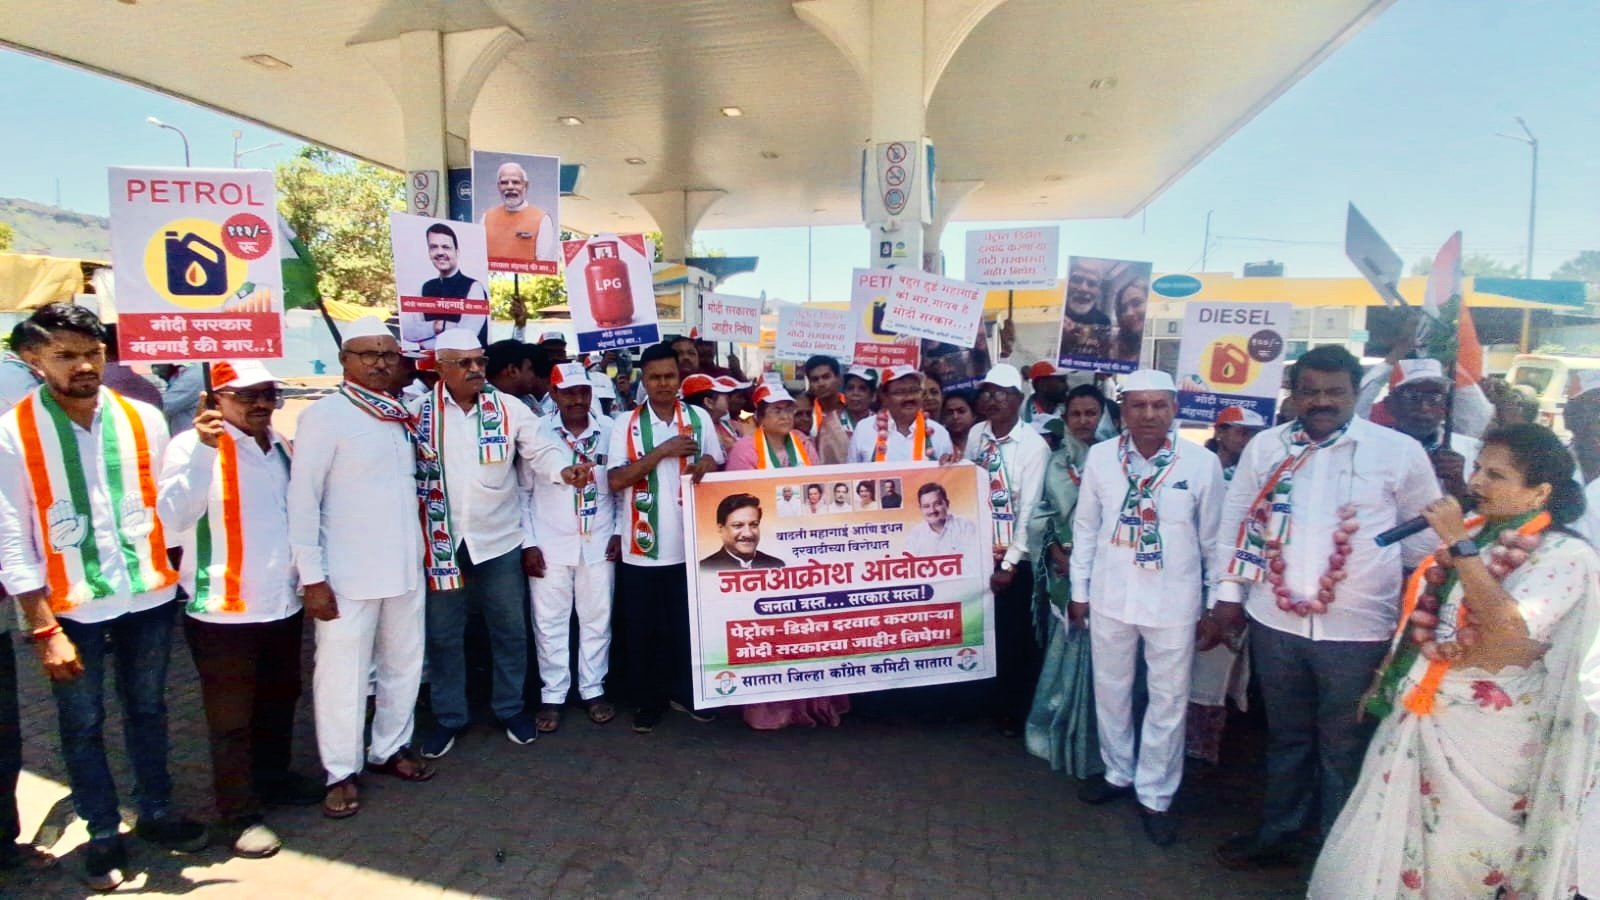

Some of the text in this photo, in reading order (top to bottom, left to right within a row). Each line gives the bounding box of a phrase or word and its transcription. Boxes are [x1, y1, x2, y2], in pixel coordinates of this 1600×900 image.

[127, 179, 264, 206] PETROL
[595, 278, 622, 291] LPG
[893, 304, 916, 320] मोदी
[1199, 308, 1276, 325] DIESEL
[150, 316, 252, 332] मोदी सरकार
[192, 335, 217, 352] की
[221, 338, 274, 353] मार..!
[852, 522, 877, 536] आणि
[792, 539, 889, 558] दरवाढीच्या विरोधात
[861, 552, 964, 581] आंदोलन
[760, 598, 796, 613] जनता
[848, 590, 889, 606] सरकार
[891, 585, 926, 601] मस्त!
[832, 615, 880, 631] दरवाढ
[736, 627, 951, 659] मोदी सरकारचा जाहीर निषेध!
[741, 671, 782, 687] सातारा
[788, 669, 825, 684] जिल्हा
[870, 657, 909, 675] कमिटी
[914, 656, 953, 670] सातारा
